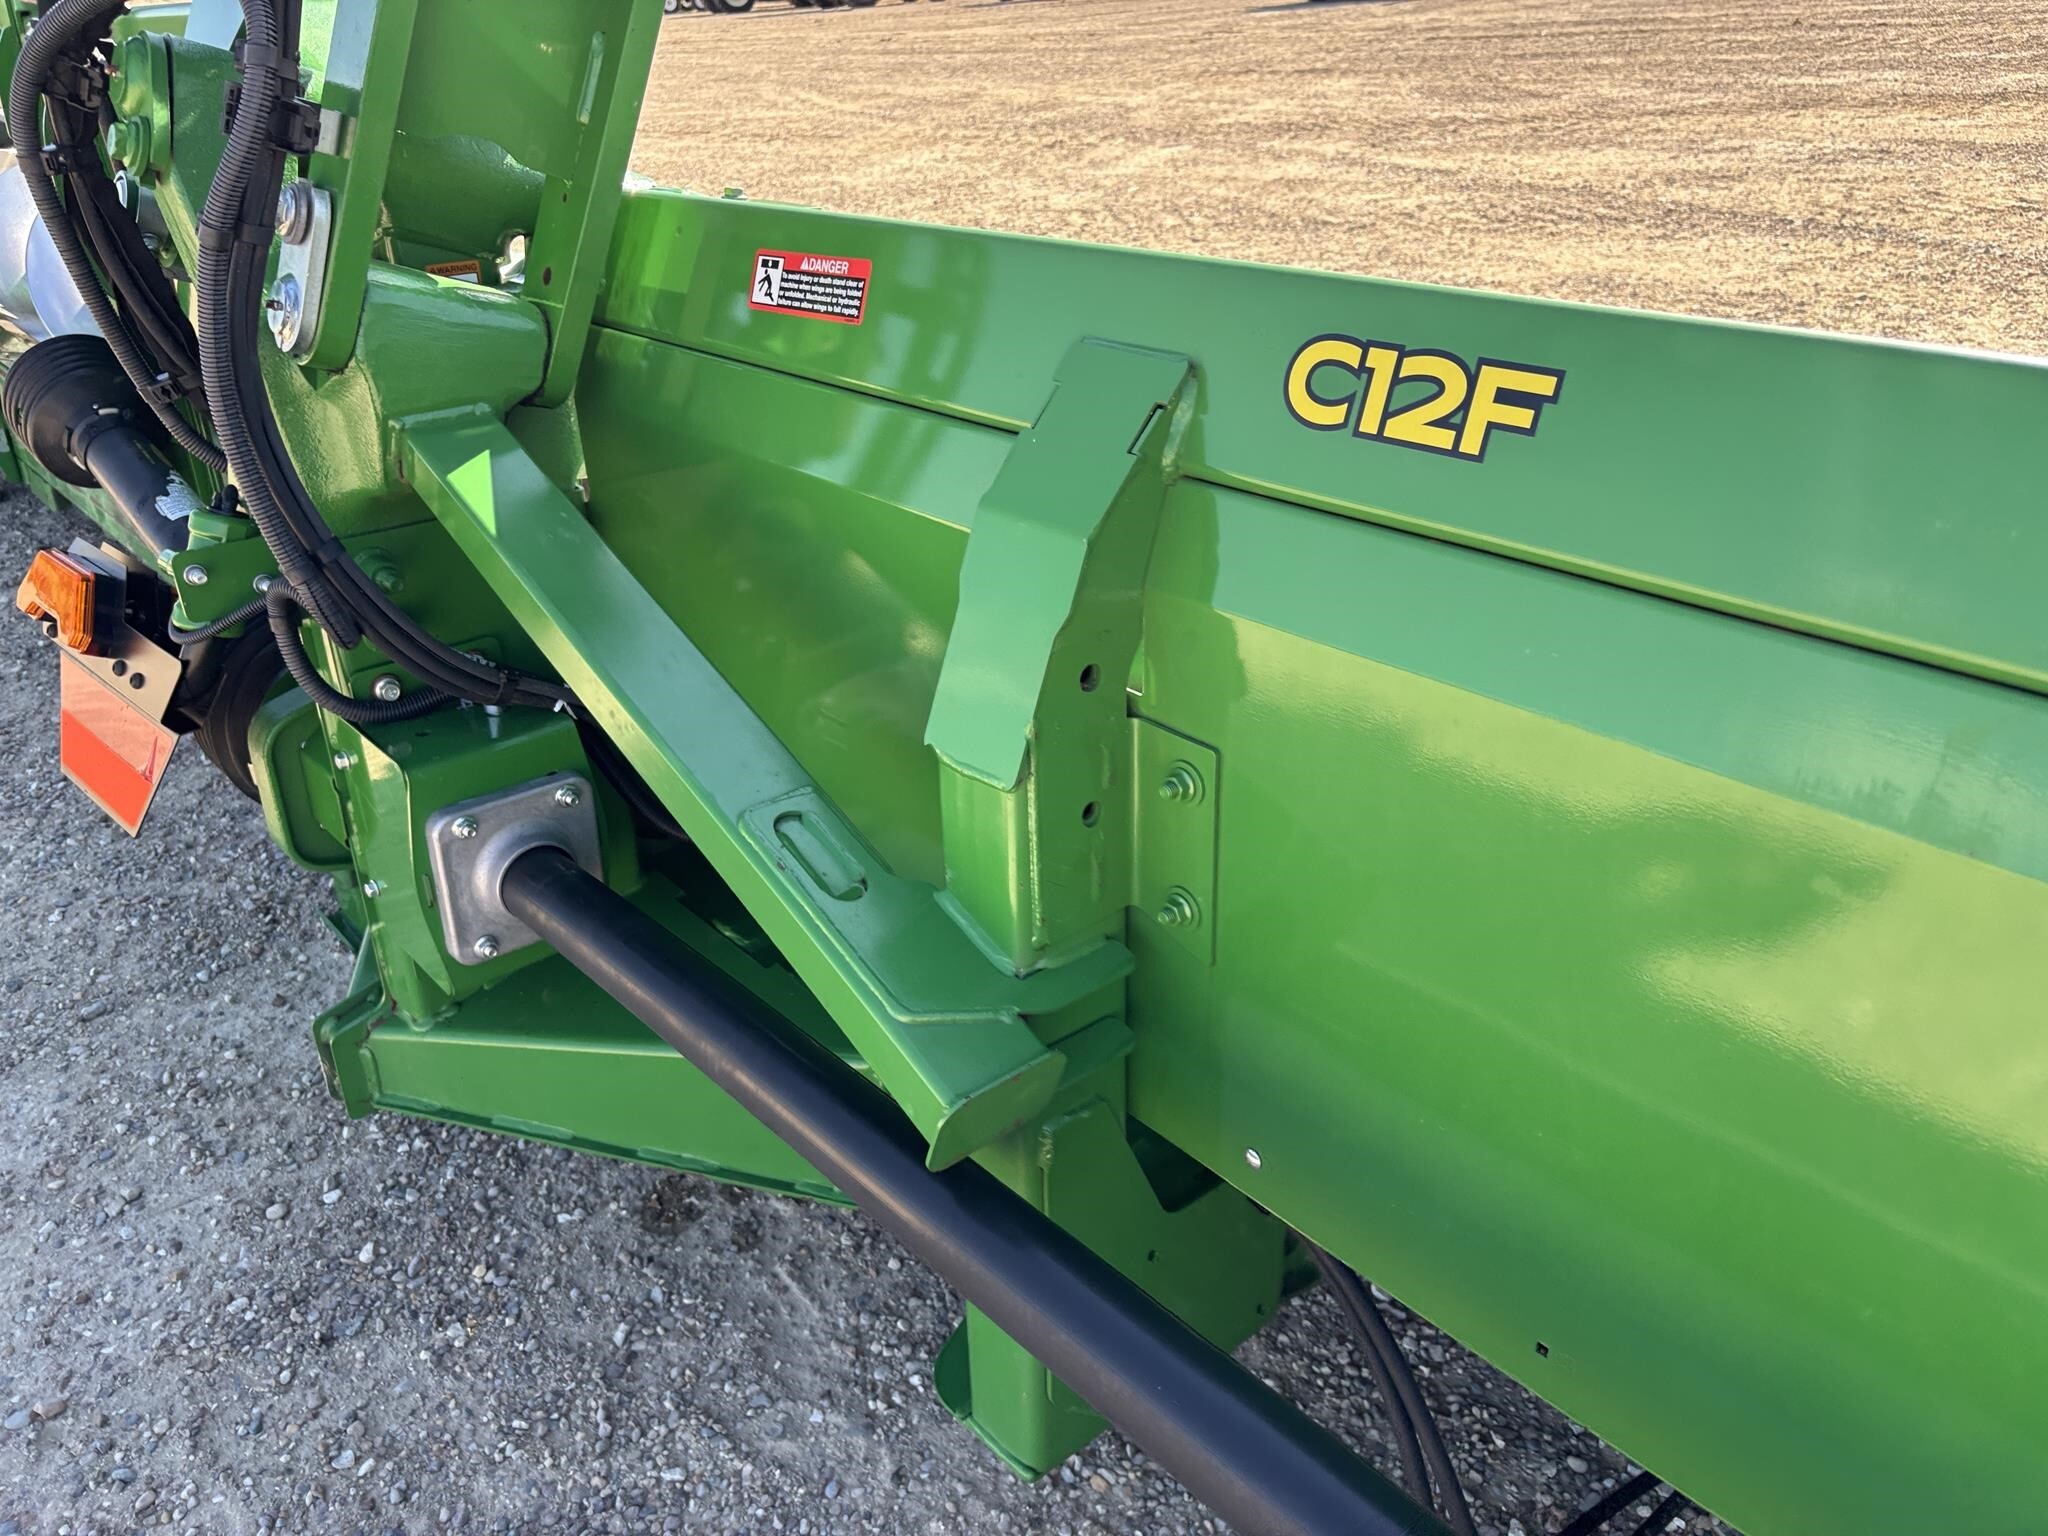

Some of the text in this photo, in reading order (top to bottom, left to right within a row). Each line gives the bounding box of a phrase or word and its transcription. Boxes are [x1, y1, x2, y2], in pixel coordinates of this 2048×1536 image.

[437, 263, 478, 273] WARNING
[808, 258, 849, 274] DANGER
[800, 274, 813, 283] injury
[819, 276, 832, 284] death
[832, 278, 846, 286] stand
[812, 285, 824, 294] wings
[834, 287, 846, 297] being
[847, 289, 862, 297] folded
[778, 298, 791, 306] failure
[814, 303, 827, 312] wings
[806, 293, 832, 302] Mechanical
[838, 297, 860, 306] hydraulic
[1285, 335, 1565, 461] C12F
